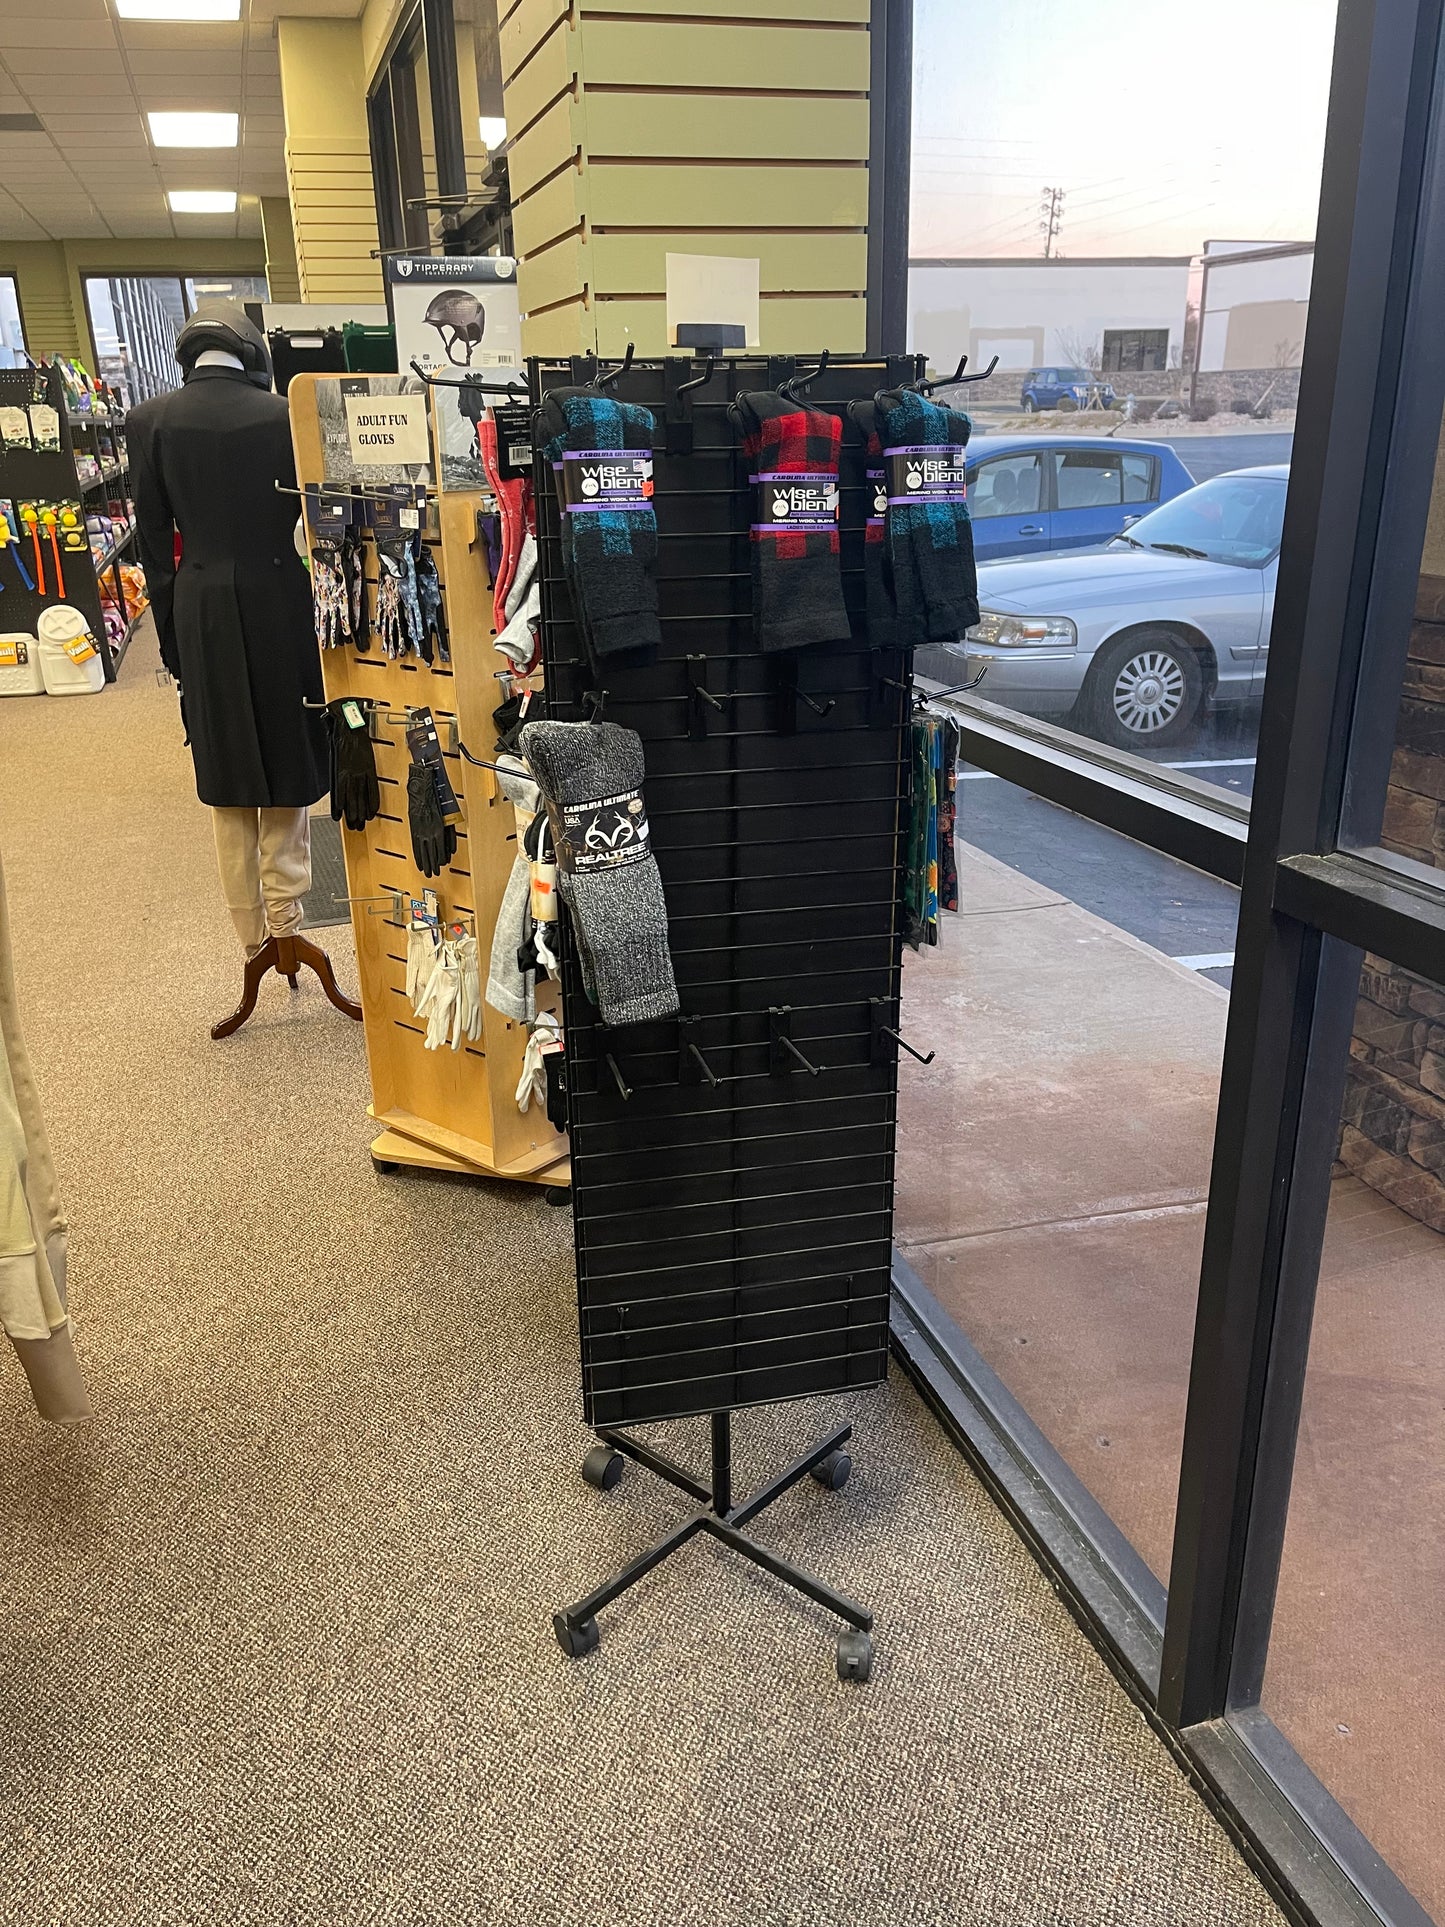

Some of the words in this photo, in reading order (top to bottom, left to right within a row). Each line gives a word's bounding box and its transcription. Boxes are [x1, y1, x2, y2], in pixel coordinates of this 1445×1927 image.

[415, 264, 474, 272] TIPPERARY
[357, 415, 387, 426] ADULT
[389, 414, 408, 426] FUN
[358, 434, 395, 445] GLOVES
[924, 469, 964, 483] blend
[790, 499, 829, 511] blen
[68, 641, 89, 657] Vault
[563, 800, 602, 813] CAROLINA
[603, 789, 640, 806] ULTIMATE
[564, 816, 581, 825] USA
[574, 840, 647, 866] REALTREE
